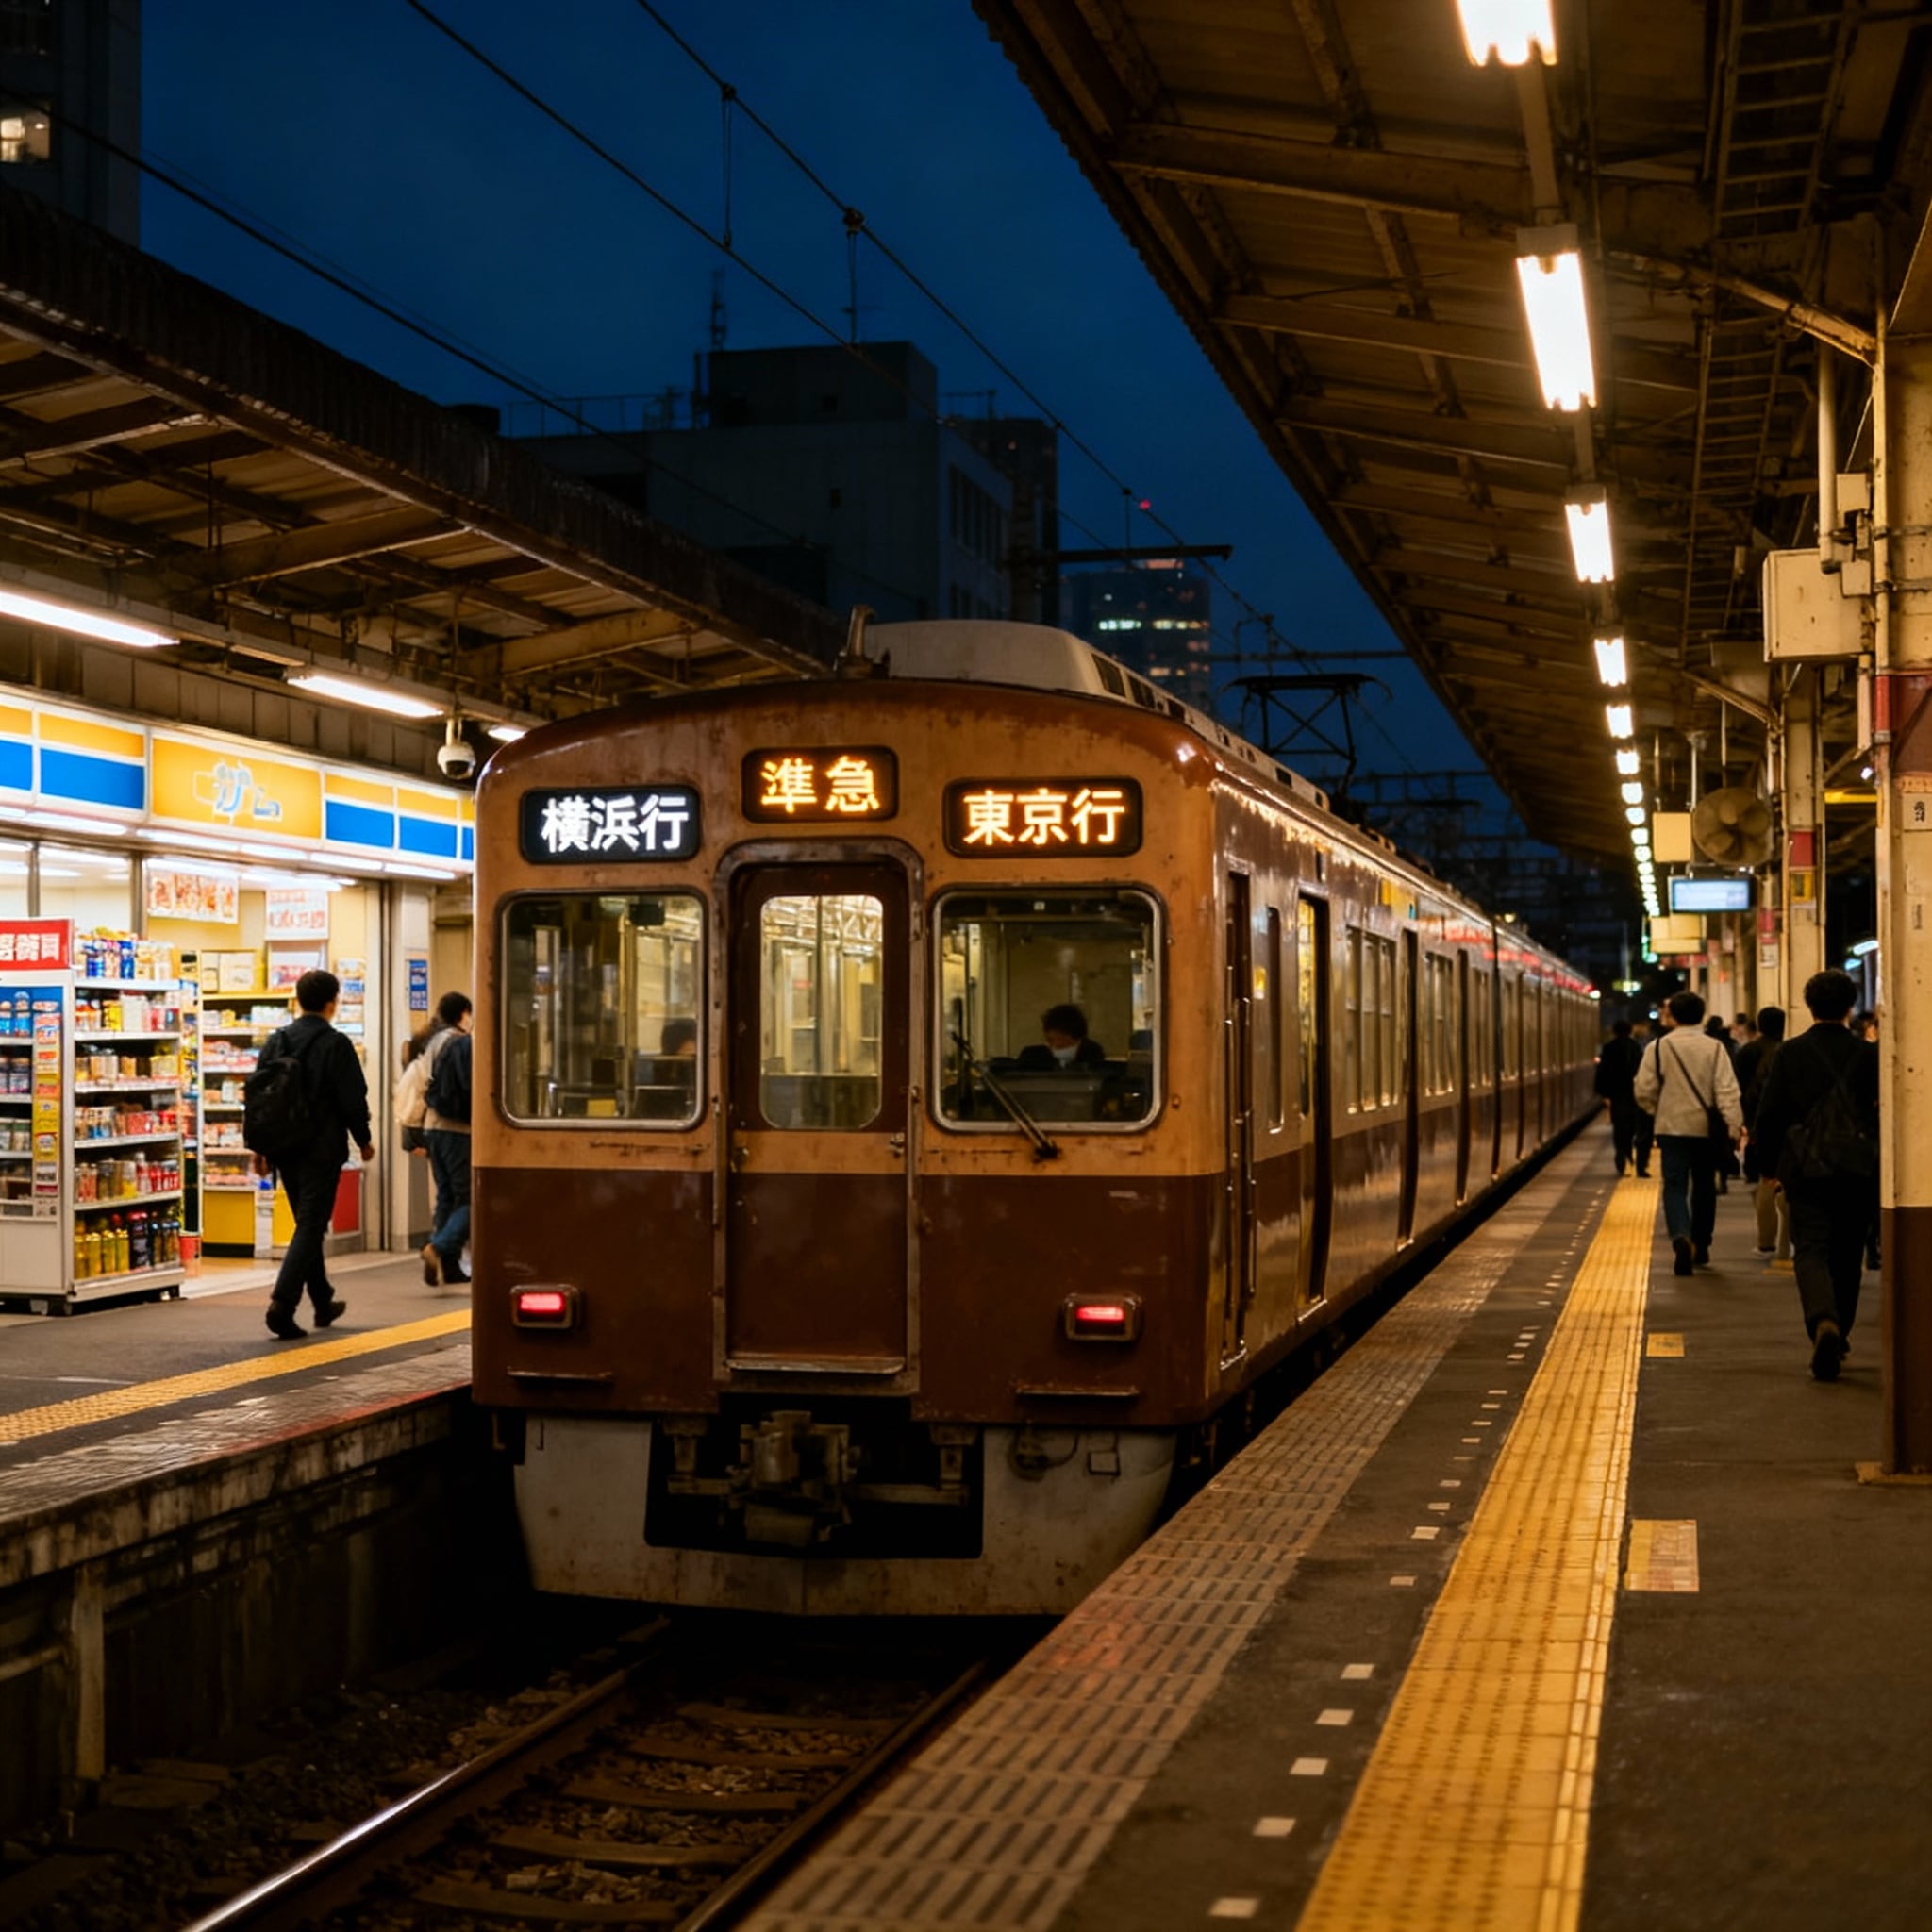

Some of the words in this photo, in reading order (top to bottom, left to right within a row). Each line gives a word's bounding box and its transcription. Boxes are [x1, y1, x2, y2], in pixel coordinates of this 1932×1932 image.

[759, 755, 881, 815] 準急
[541, 793, 690, 853] 横浜行
[962, 787, 1125, 846] 東京行
